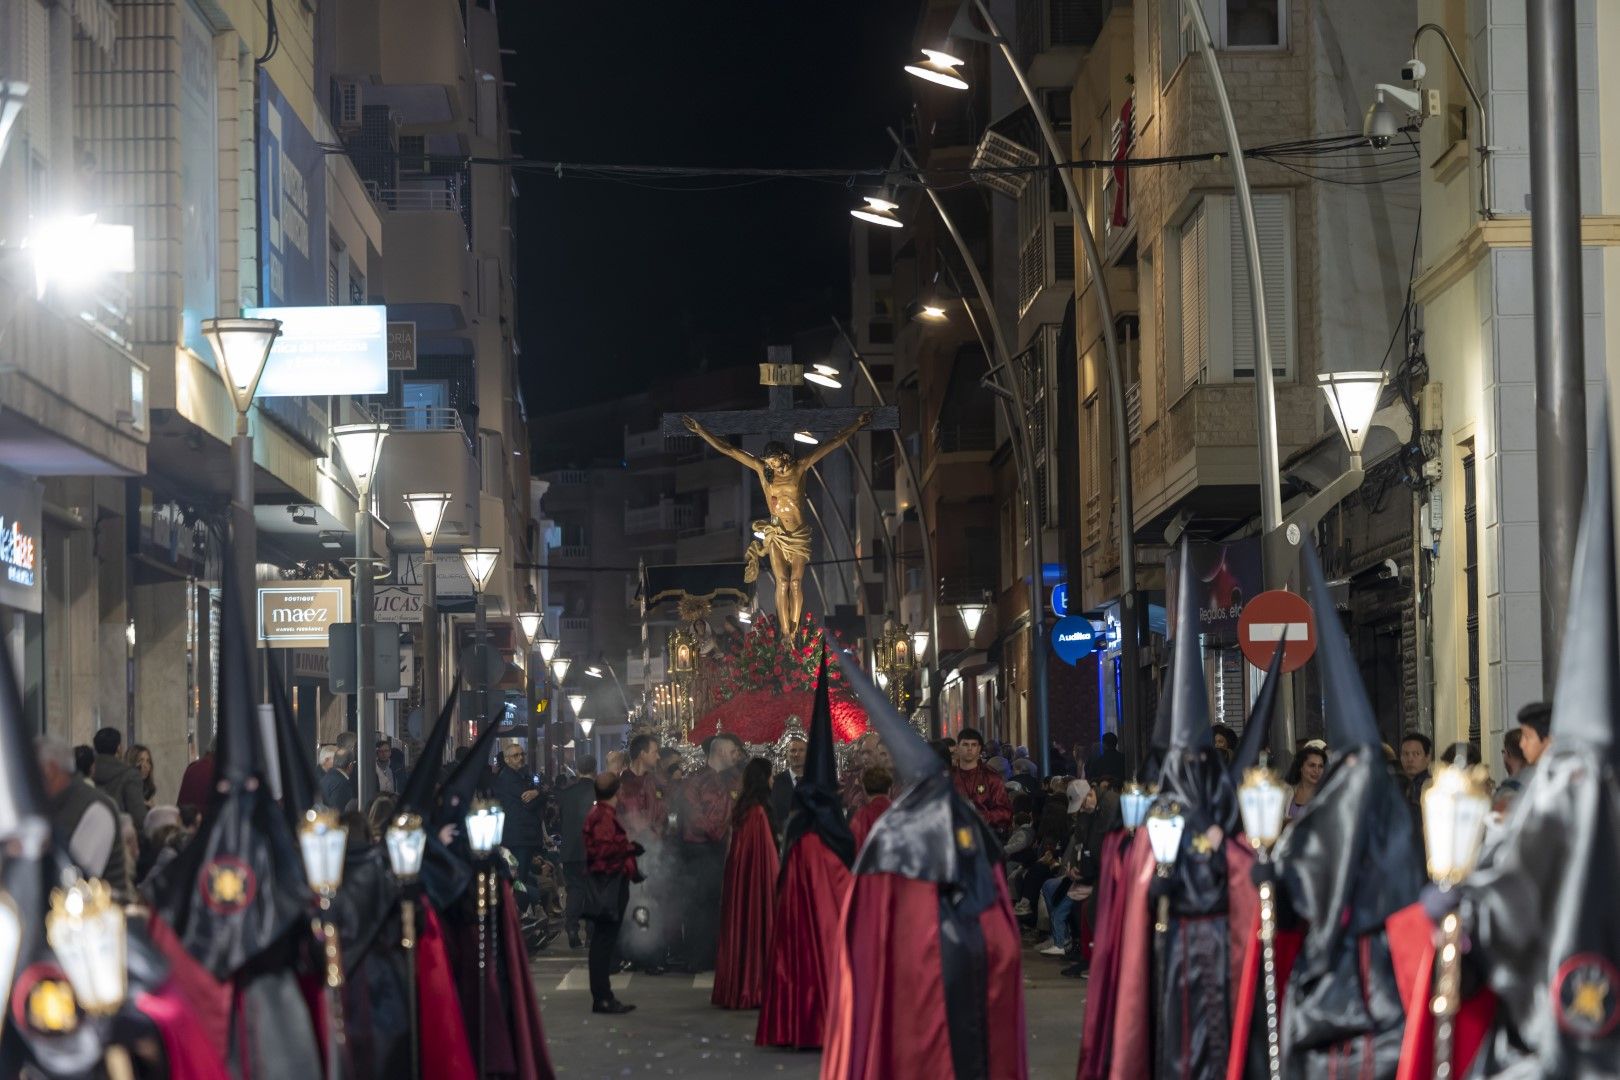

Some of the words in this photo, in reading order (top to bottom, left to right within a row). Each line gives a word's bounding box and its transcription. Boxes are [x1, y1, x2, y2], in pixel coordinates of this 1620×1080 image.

[375, 596, 423, 612] LICAS
[271, 607, 328, 623] maez
[1058, 631, 1092, 642] Audika
